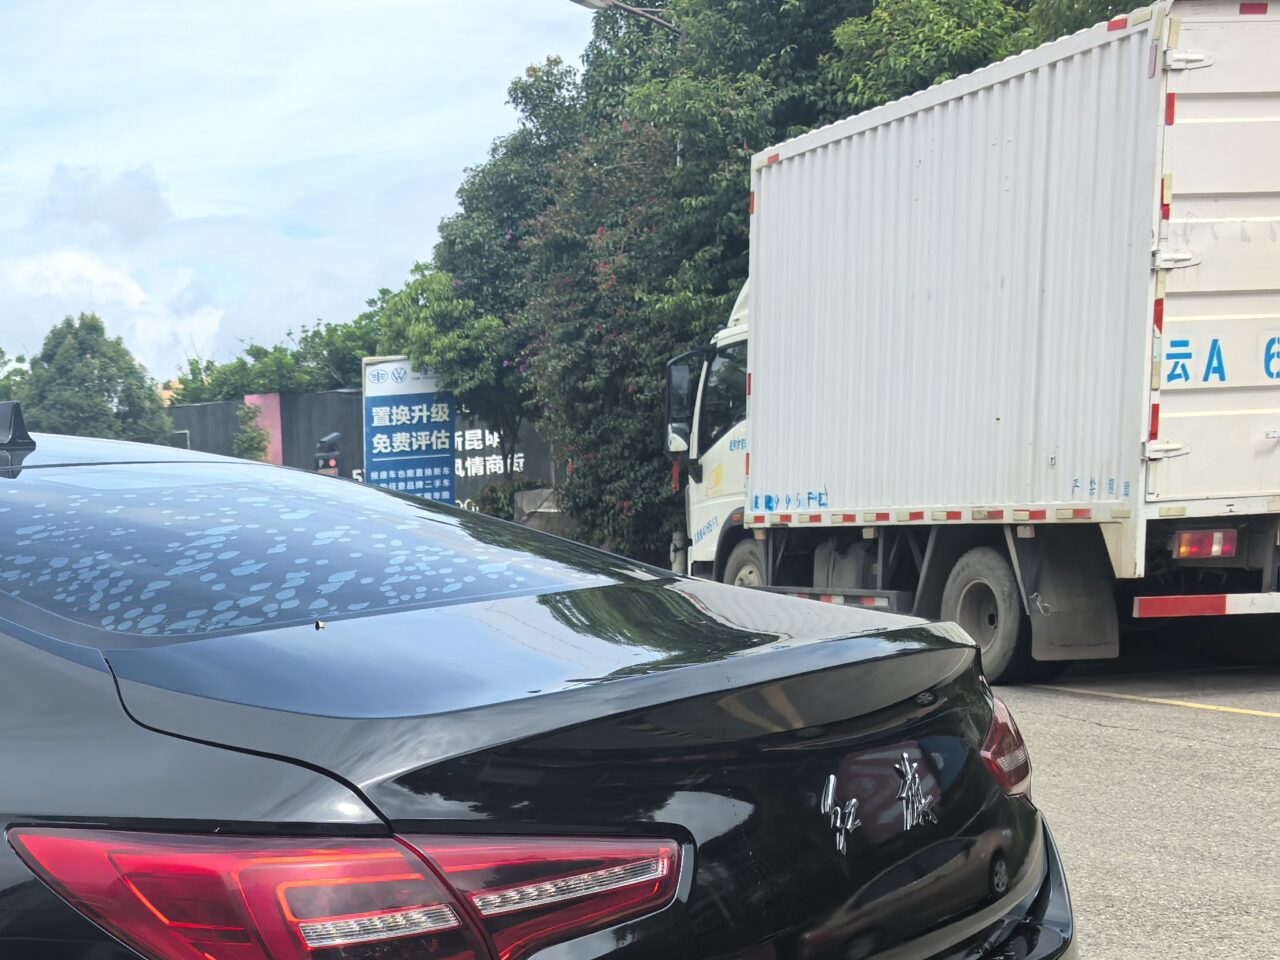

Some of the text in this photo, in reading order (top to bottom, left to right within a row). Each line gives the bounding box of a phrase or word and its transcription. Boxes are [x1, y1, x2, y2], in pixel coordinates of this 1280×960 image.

[371, 403, 450, 427] 置换升级
[372, 431, 450, 454] 免费评估
